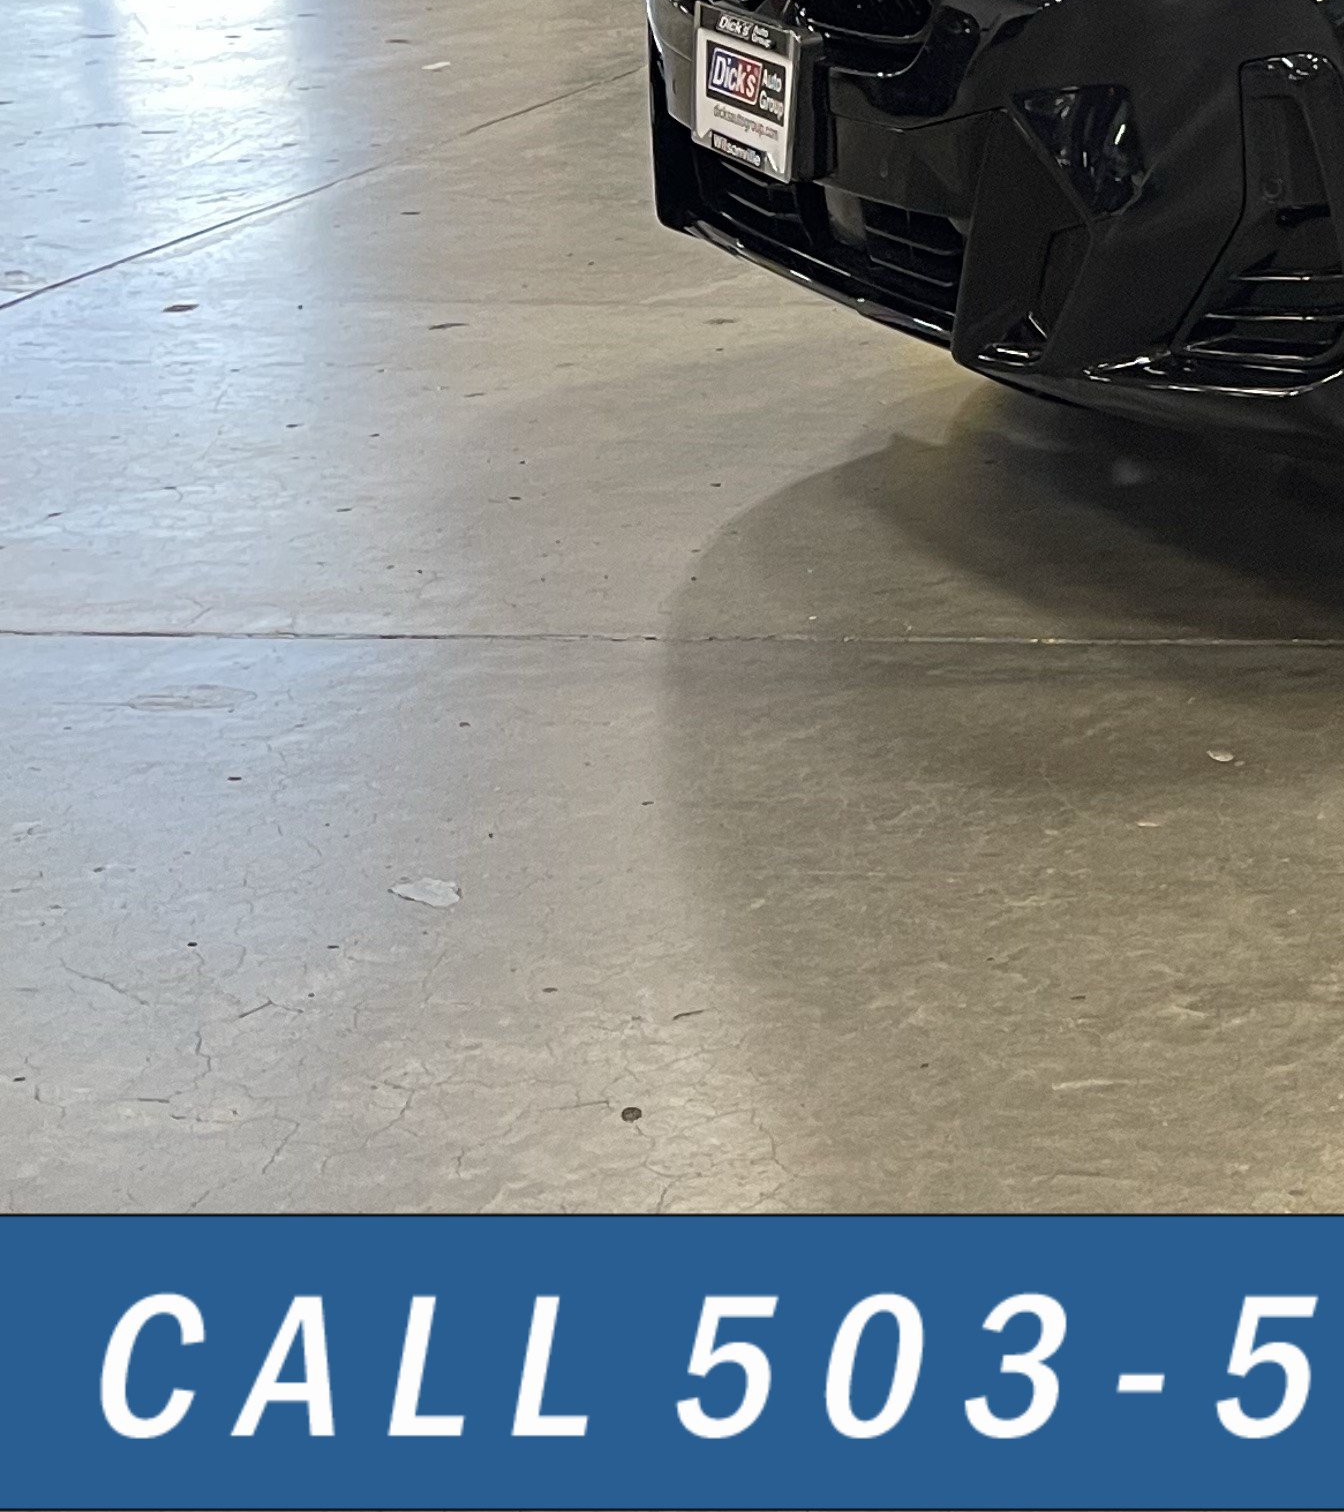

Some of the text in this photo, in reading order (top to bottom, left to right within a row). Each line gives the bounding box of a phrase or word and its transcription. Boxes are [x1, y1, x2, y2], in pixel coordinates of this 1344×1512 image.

[711, 55, 757, 98] Dick's
[761, 67, 783, 94] Auto
[758, 90, 785, 122] Group
